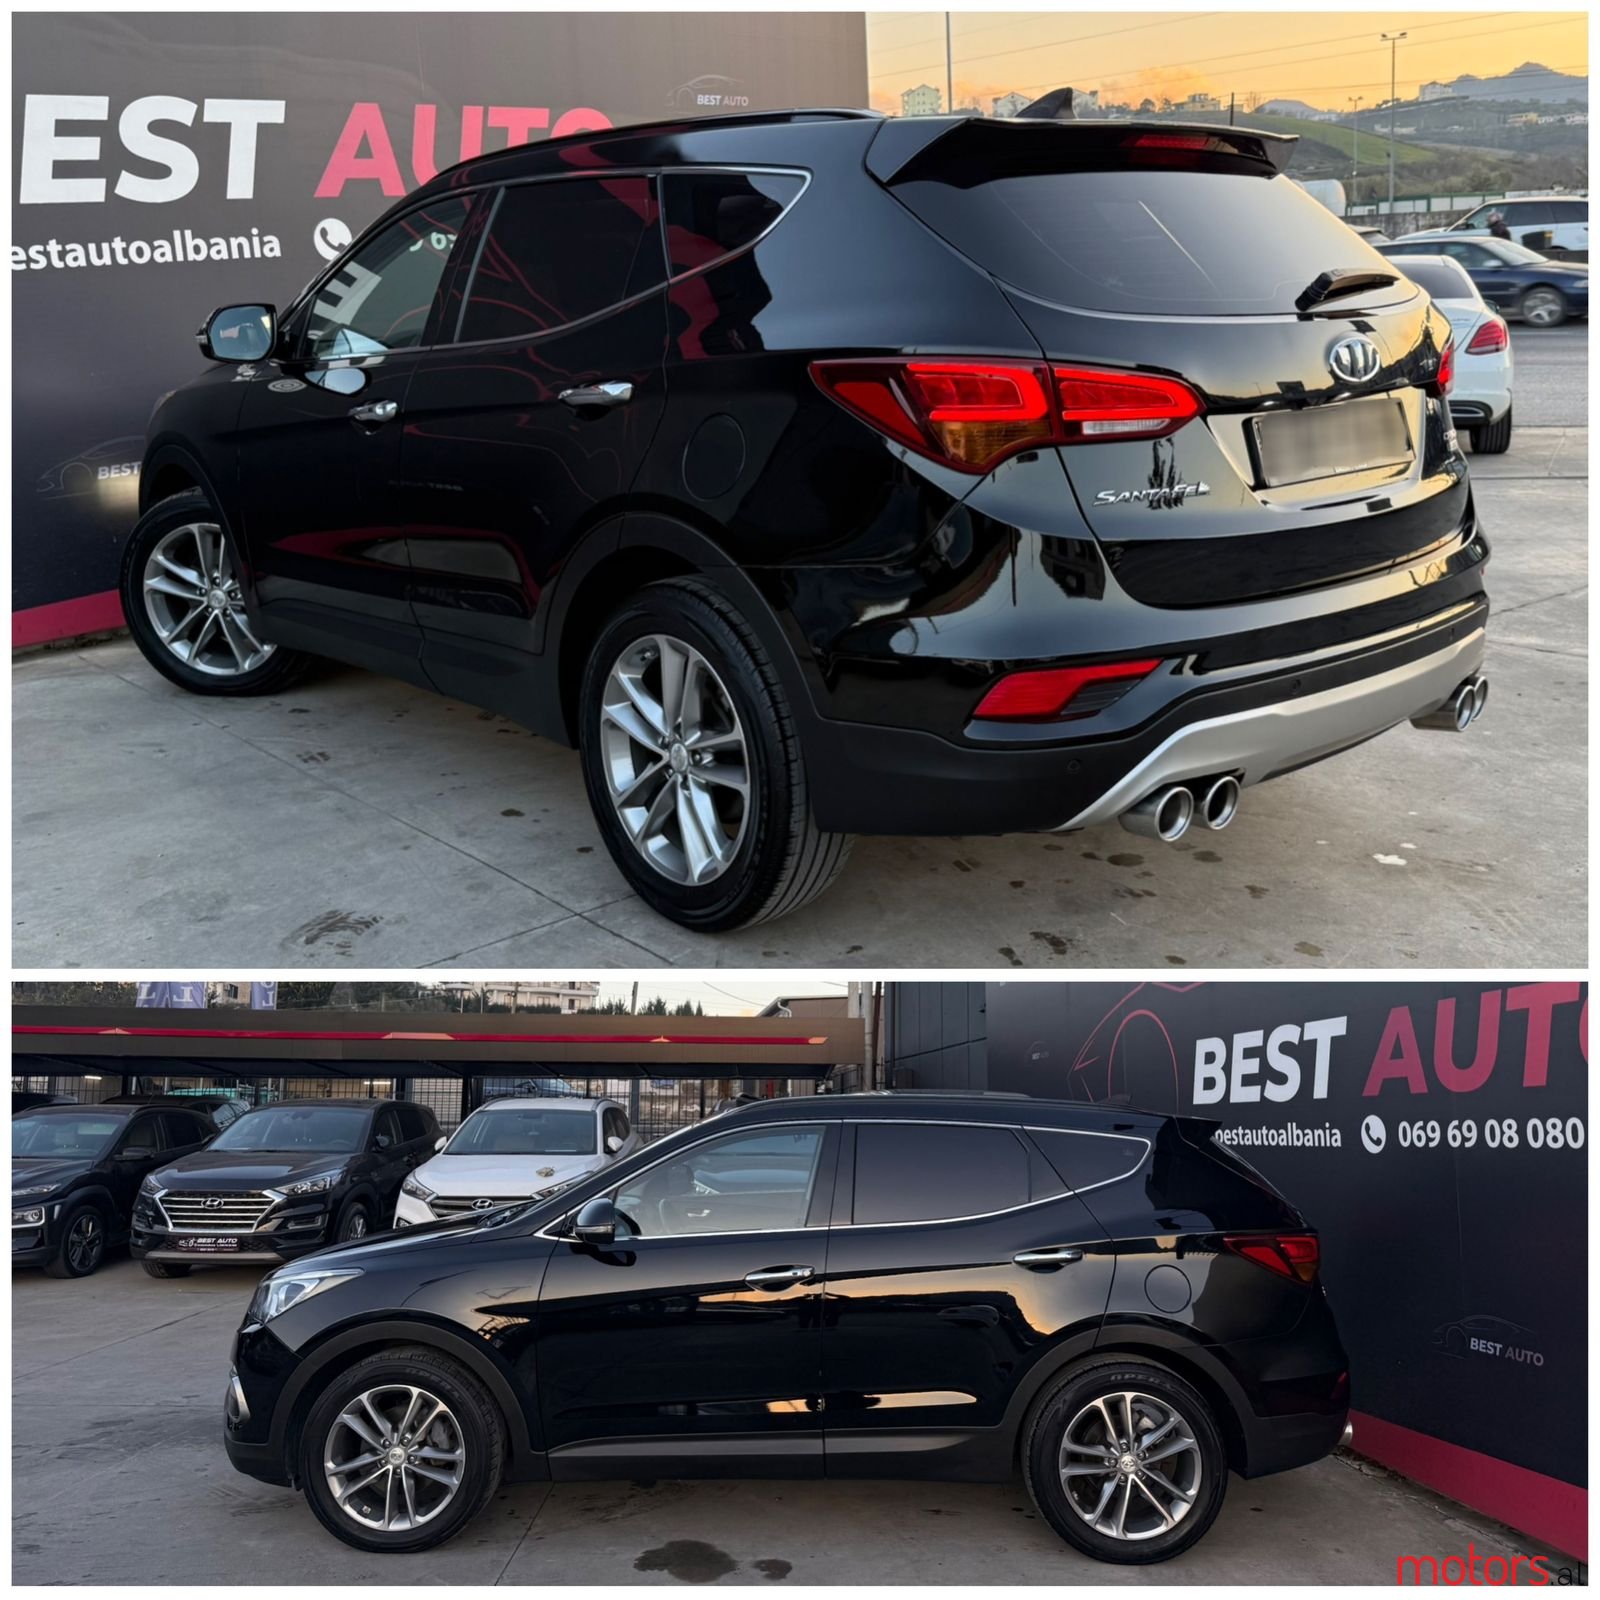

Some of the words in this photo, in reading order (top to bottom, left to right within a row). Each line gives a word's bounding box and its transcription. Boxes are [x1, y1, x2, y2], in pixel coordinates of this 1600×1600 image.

[696, 95, 721, 105] BEST
[722, 95, 749, 106] AUTO
[312, 102, 614, 198] AUT
[97, 461, 142, 480] BEST
[1193, 1015, 1348, 1105] BEST
[1361, 981, 1588, 1095] AUT
[1398, 1120, 1441, 1148] 069
[1446, 1119, 1478, 1148] 69
[1484, 1118, 1520, 1148] 08
[1526, 1116, 1585, 1149] 080
[1470, 1337, 1503, 1356] BEST
[1505, 1346, 1544, 1367] AUTO
